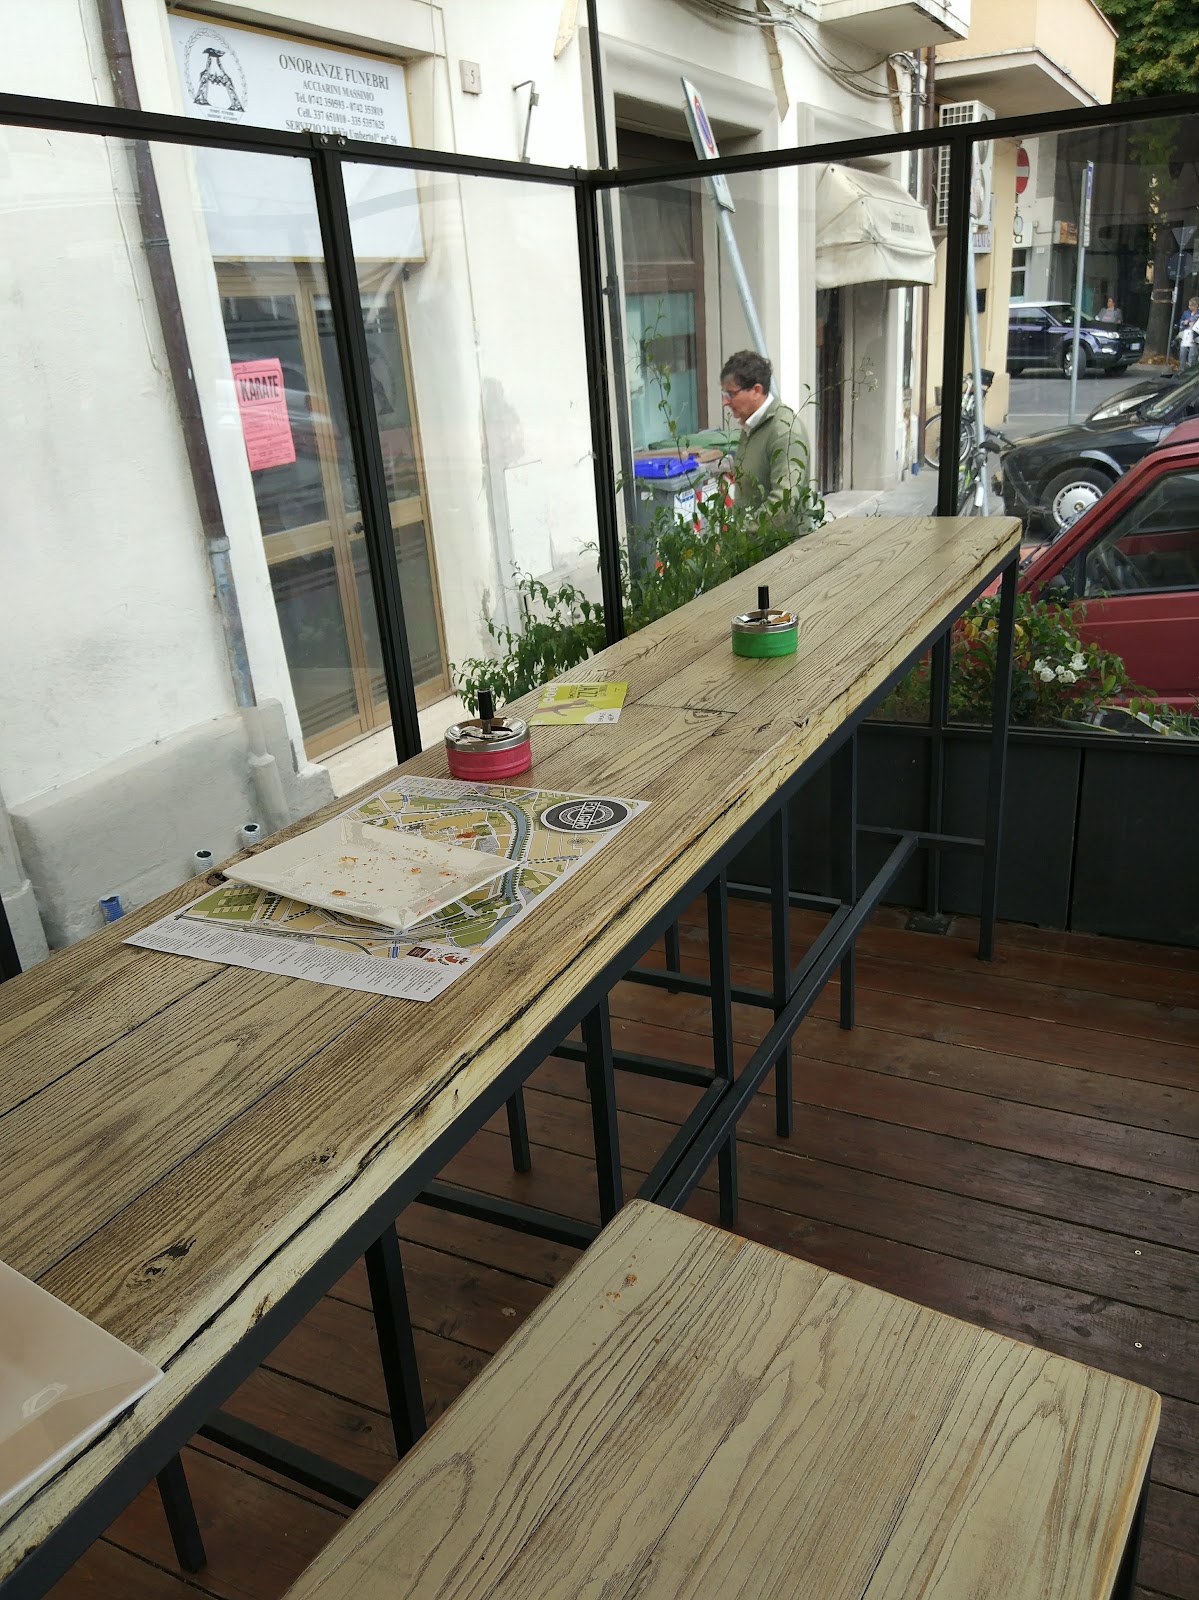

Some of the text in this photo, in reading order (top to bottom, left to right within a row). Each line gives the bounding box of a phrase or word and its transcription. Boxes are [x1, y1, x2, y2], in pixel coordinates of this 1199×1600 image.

[279, 54, 390, 90] ONORANZE FUNEBRI
[295, 92, 307, 104] Tel.
[303, 80, 375, 102] ACCIARINI MASSIMO
[297, 106, 312, 119] Cell.
[239, 375, 280, 402] KARATE
